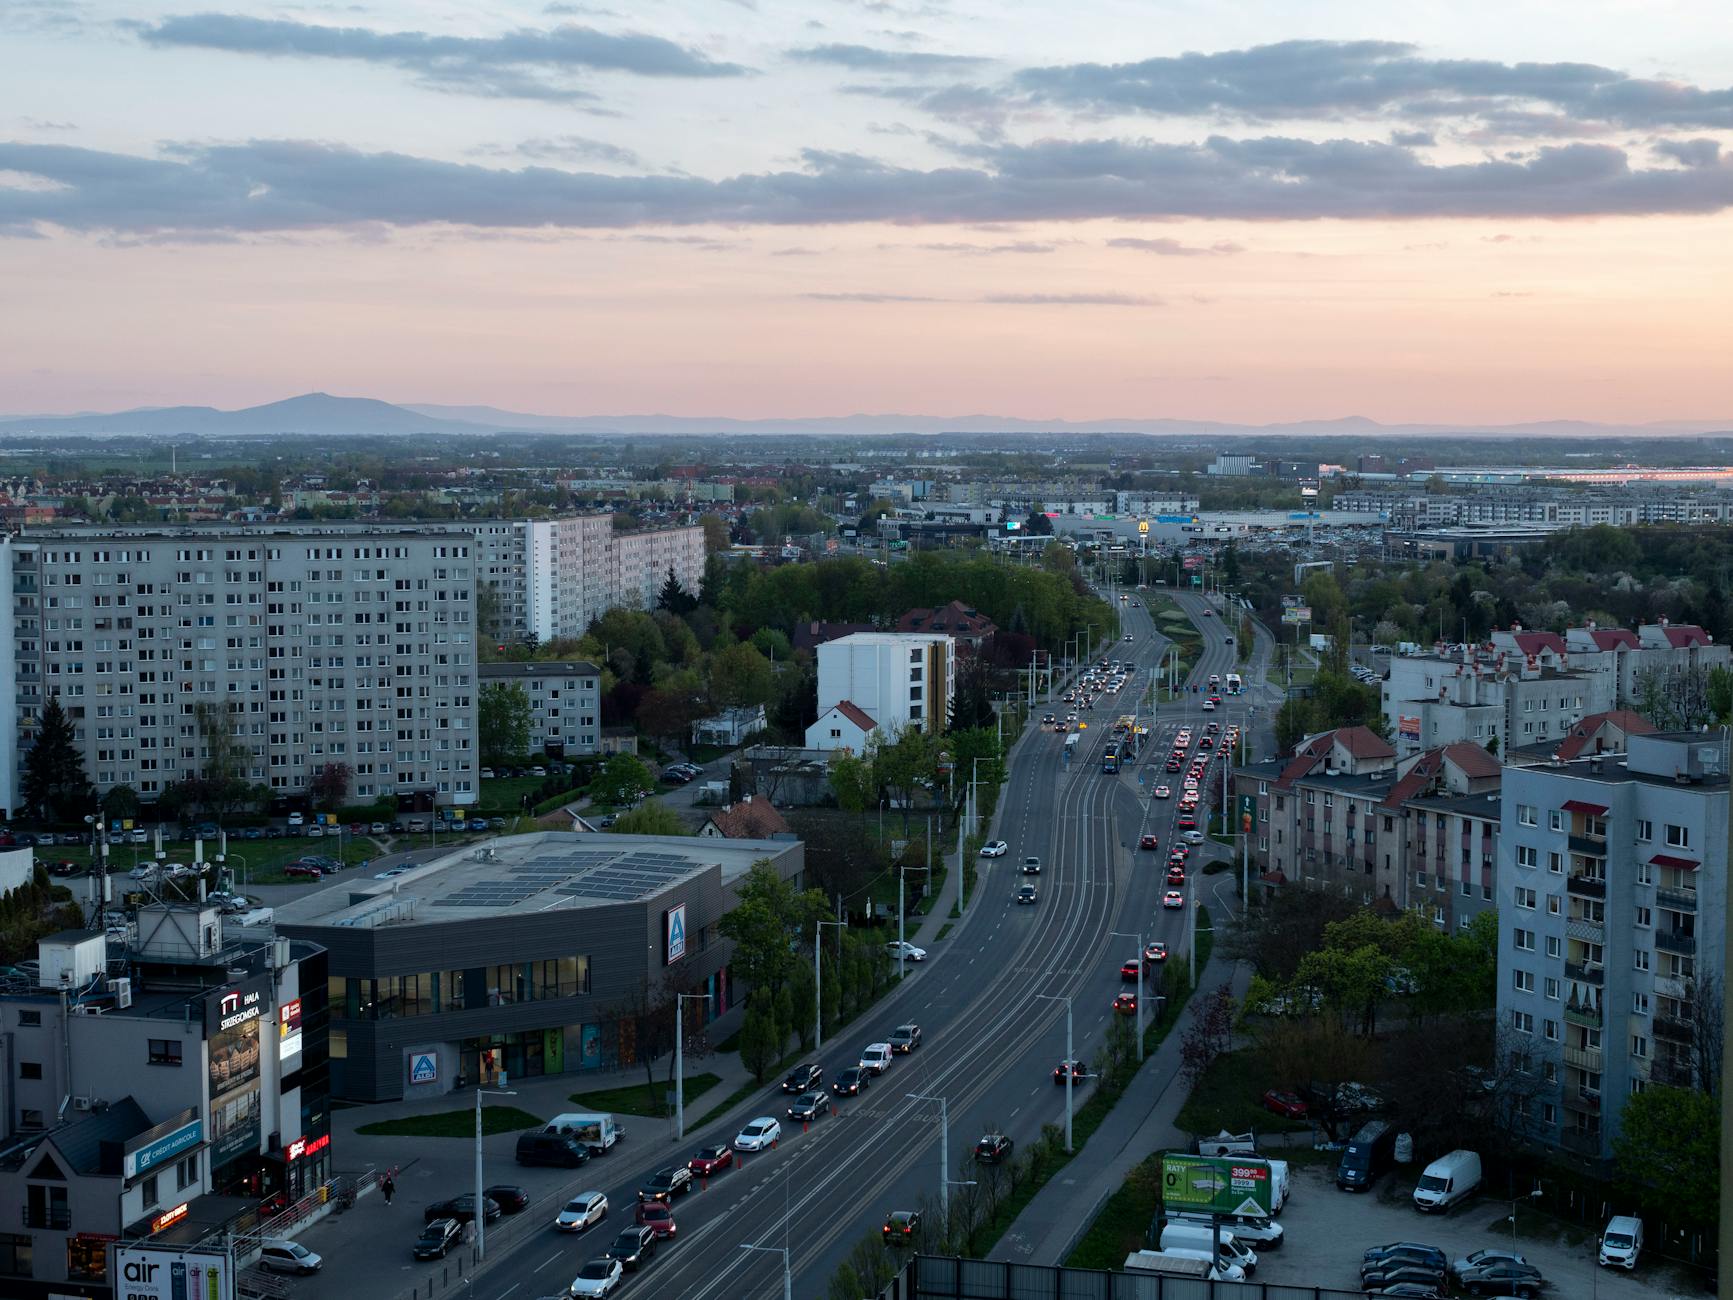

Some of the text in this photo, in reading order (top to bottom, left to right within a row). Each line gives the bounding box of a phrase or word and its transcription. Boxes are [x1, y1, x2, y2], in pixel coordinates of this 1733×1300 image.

[244, 992, 260, 1005] HALA
[221, 1006, 260, 1031] STRZEGOMSKA
[414, 1072, 435, 1081] ALDI
[152, 1131, 198, 1158] CRÉDIT AGRICOLE
[1166, 1164, 1186, 1173] RATY
[124, 1256, 160, 1283] air
[172, 1266, 185, 1276] air
[190, 1266, 202, 1277] air
